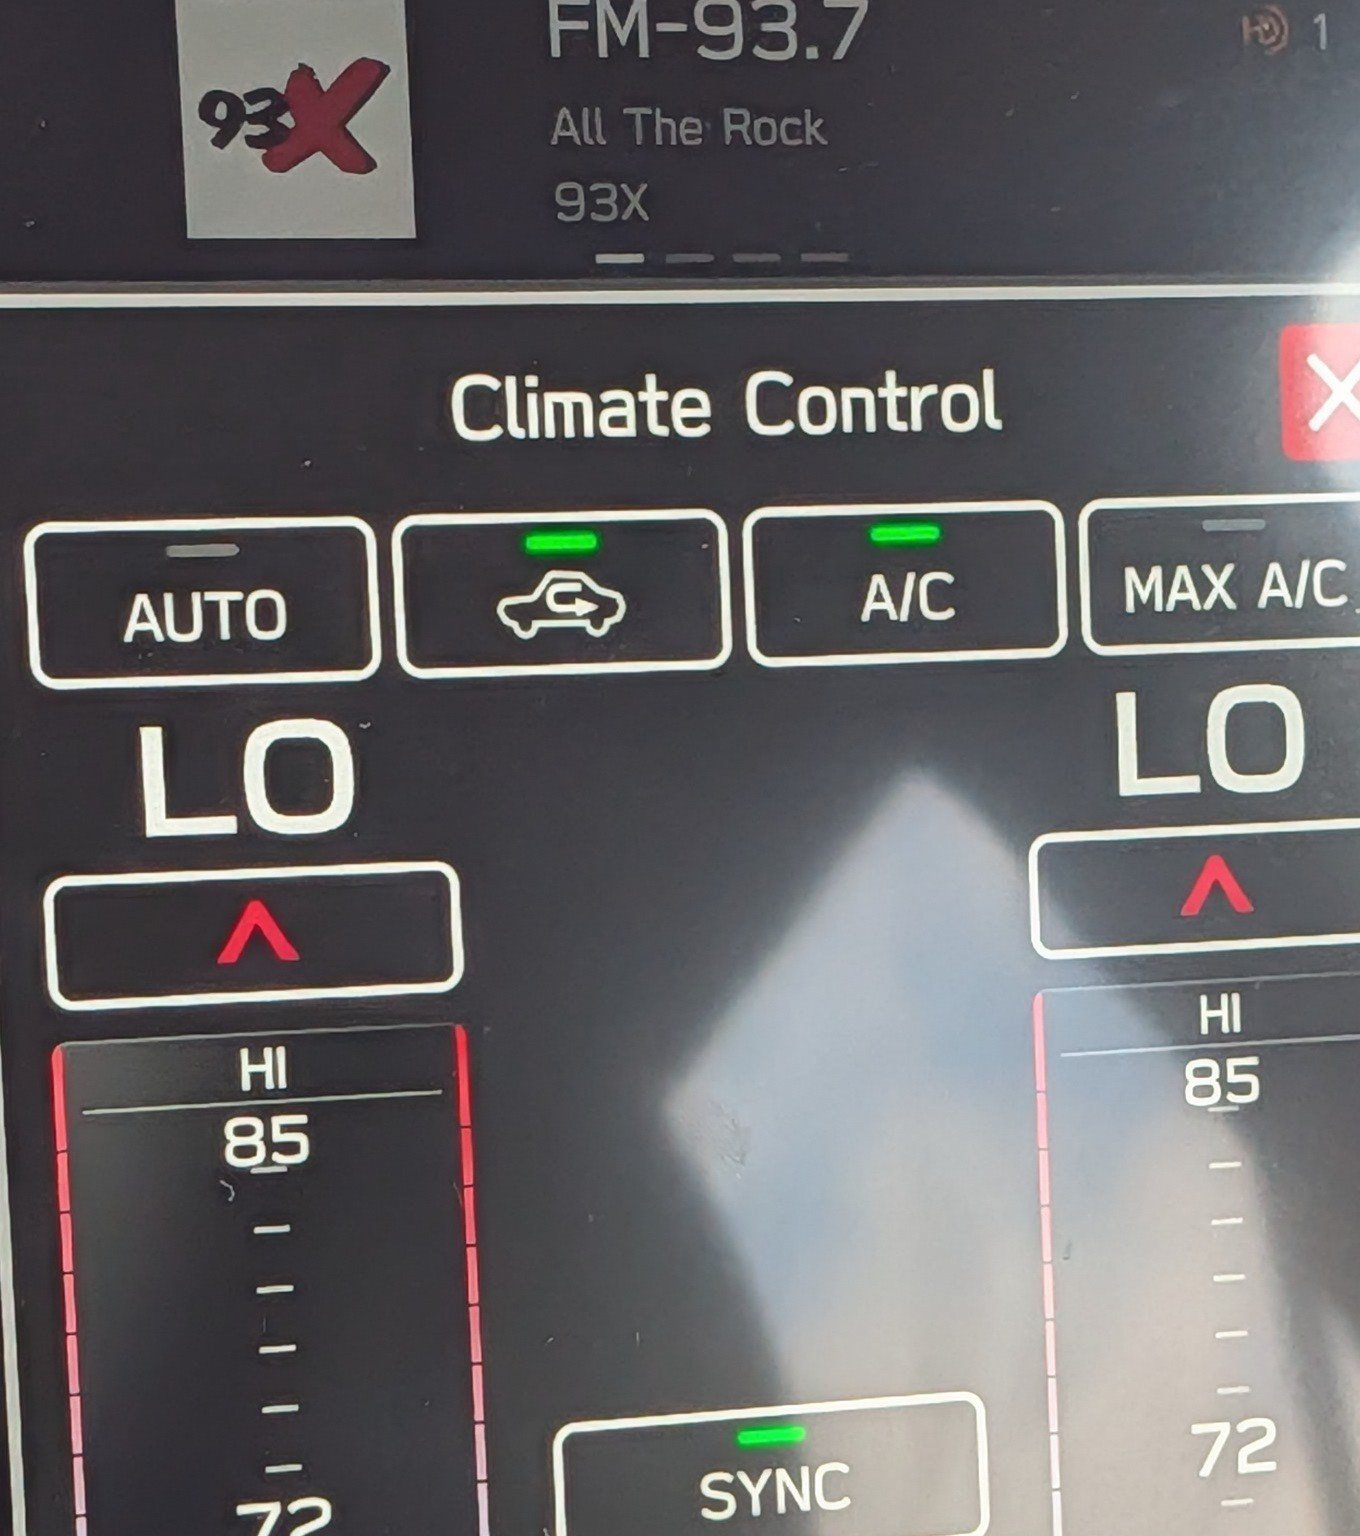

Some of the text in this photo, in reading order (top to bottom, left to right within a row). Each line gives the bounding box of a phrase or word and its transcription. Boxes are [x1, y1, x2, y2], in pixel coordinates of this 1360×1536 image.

[548, 0, 869, 62] FM-93.7
[1313, 13, 1328, 51] 1
[198, 57, 391, 174] 93X
[551, 107, 829, 147] All The Rock
[554, 181, 650, 223] 93X
[450, 368, 1003, 442] Climate Control
[860, 571, 956, 623] A/C
[1124, 558, 1349, 614] MAX A/C
[123, 589, 287, 643] AUTO
[1115, 683, 1306, 798] LO
[139, 717, 355, 838] LO
[1199, 992, 1241, 1035] HI
[240, 1045, 288, 1092] HI
[1184, 1056, 1260, 1106] 85
[224, 1114, 310, 1168] 85
[1190, 1417, 1277, 1477] 72
[699, 1461, 852, 1521] SYNC
